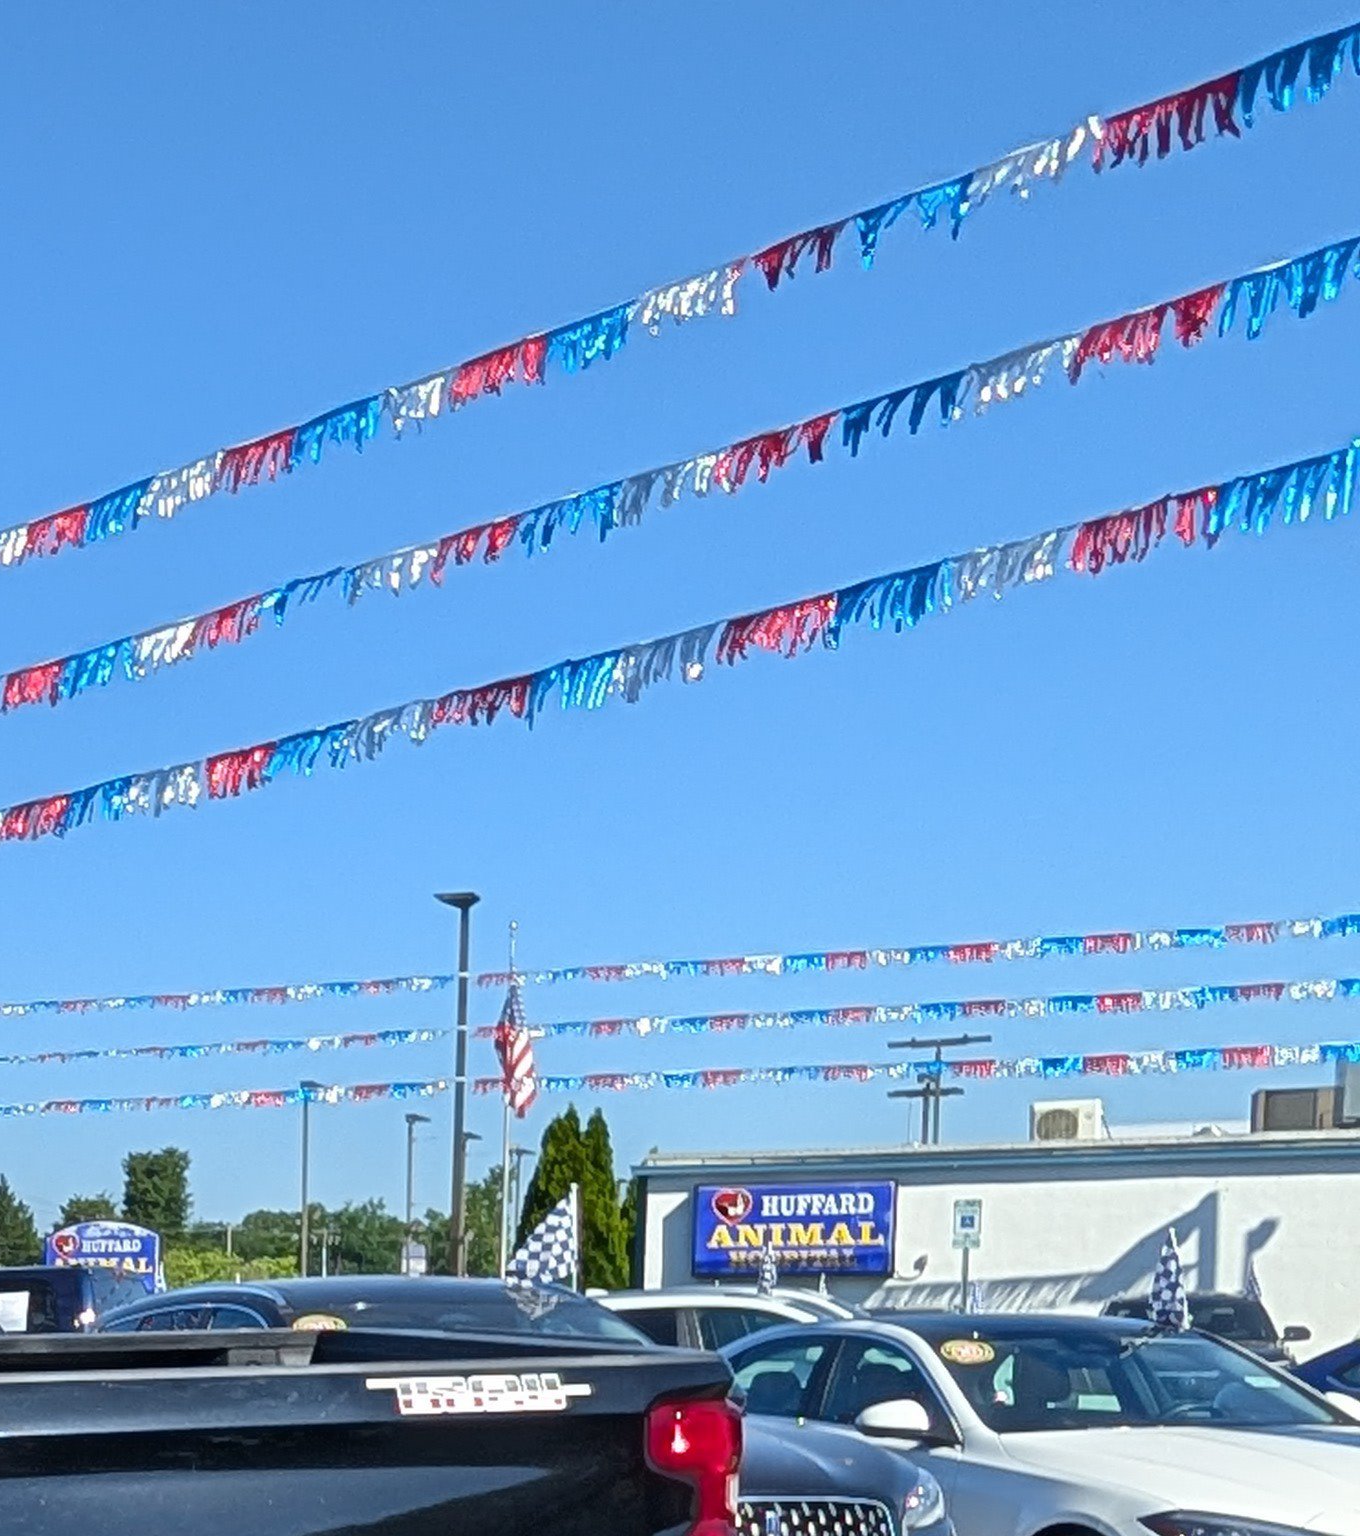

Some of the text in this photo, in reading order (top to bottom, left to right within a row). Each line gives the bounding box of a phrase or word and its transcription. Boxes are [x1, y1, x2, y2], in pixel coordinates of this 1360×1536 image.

[760, 1192, 875, 1217] HUFFARD
[81, 1239, 143, 1254] HUFFARD
[706, 1221, 885, 1249] ANIMAL
